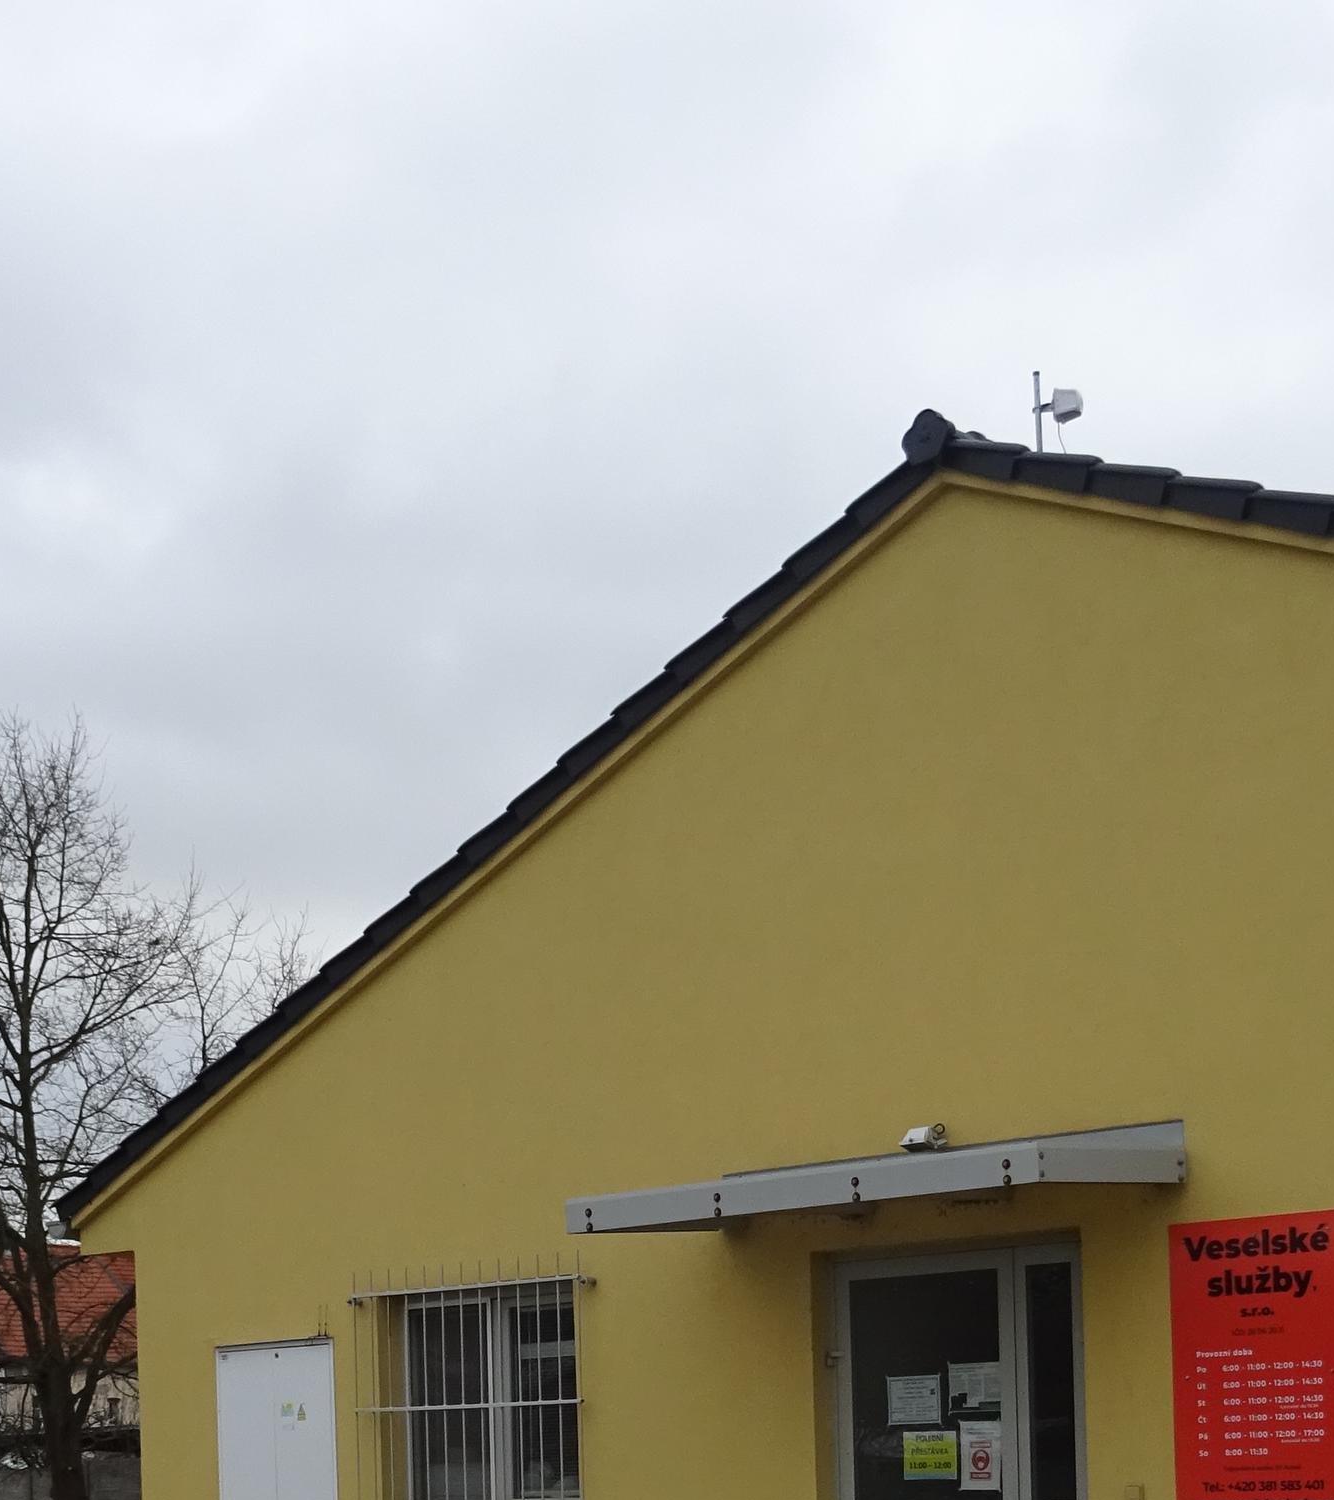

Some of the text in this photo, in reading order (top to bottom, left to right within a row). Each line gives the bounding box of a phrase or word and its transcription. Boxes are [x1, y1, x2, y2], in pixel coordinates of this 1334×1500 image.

[1183, 1223, 1329, 1261] Veselské
[1240, 1307, 1274, 1317] s.r.o.
[1196, 1349, 1252, 1358] Provozní doba
[1247, 1363, 1266, 1371] 11:00
[1274, 1362, 1293, 1370] 12:00
[1302, 1360, 1322, 1368] 14:30
[1248, 1380, 1266, 1388] 11:00
[1274, 1379, 1294, 1387] 12:00
[1248, 1397, 1267, 1405] 11:00
[1275, 1396, 1294, 1404] 12:00
[1303, 1395, 1323, 1403] 14:30
[1224, 1415, 1241, 1423] 6:00
[1249, 1414, 1267, 1422] 11:00
[1275, 1413, 1295, 1421] 12:00
[1303, 1412, 1324, 1420] 14:30
[1225, 1432, 1241, 1440] 6:00
[1249, 1431, 1268, 1439] 11:00
[1276, 1430, 1296, 1438] 12:00
[1304, 1429, 1324, 1437] 17:00
[1225, 1449, 1242, 1457] 8:00
[1250, 1448, 1268, 1456] 11:30
[1228, 1480, 1256, 1491] +420
[1259, 1480, 1276, 1491] 381
[1281, 1480, 1302, 1490] 583
[1305, 1479, 1324, 1489] 401
